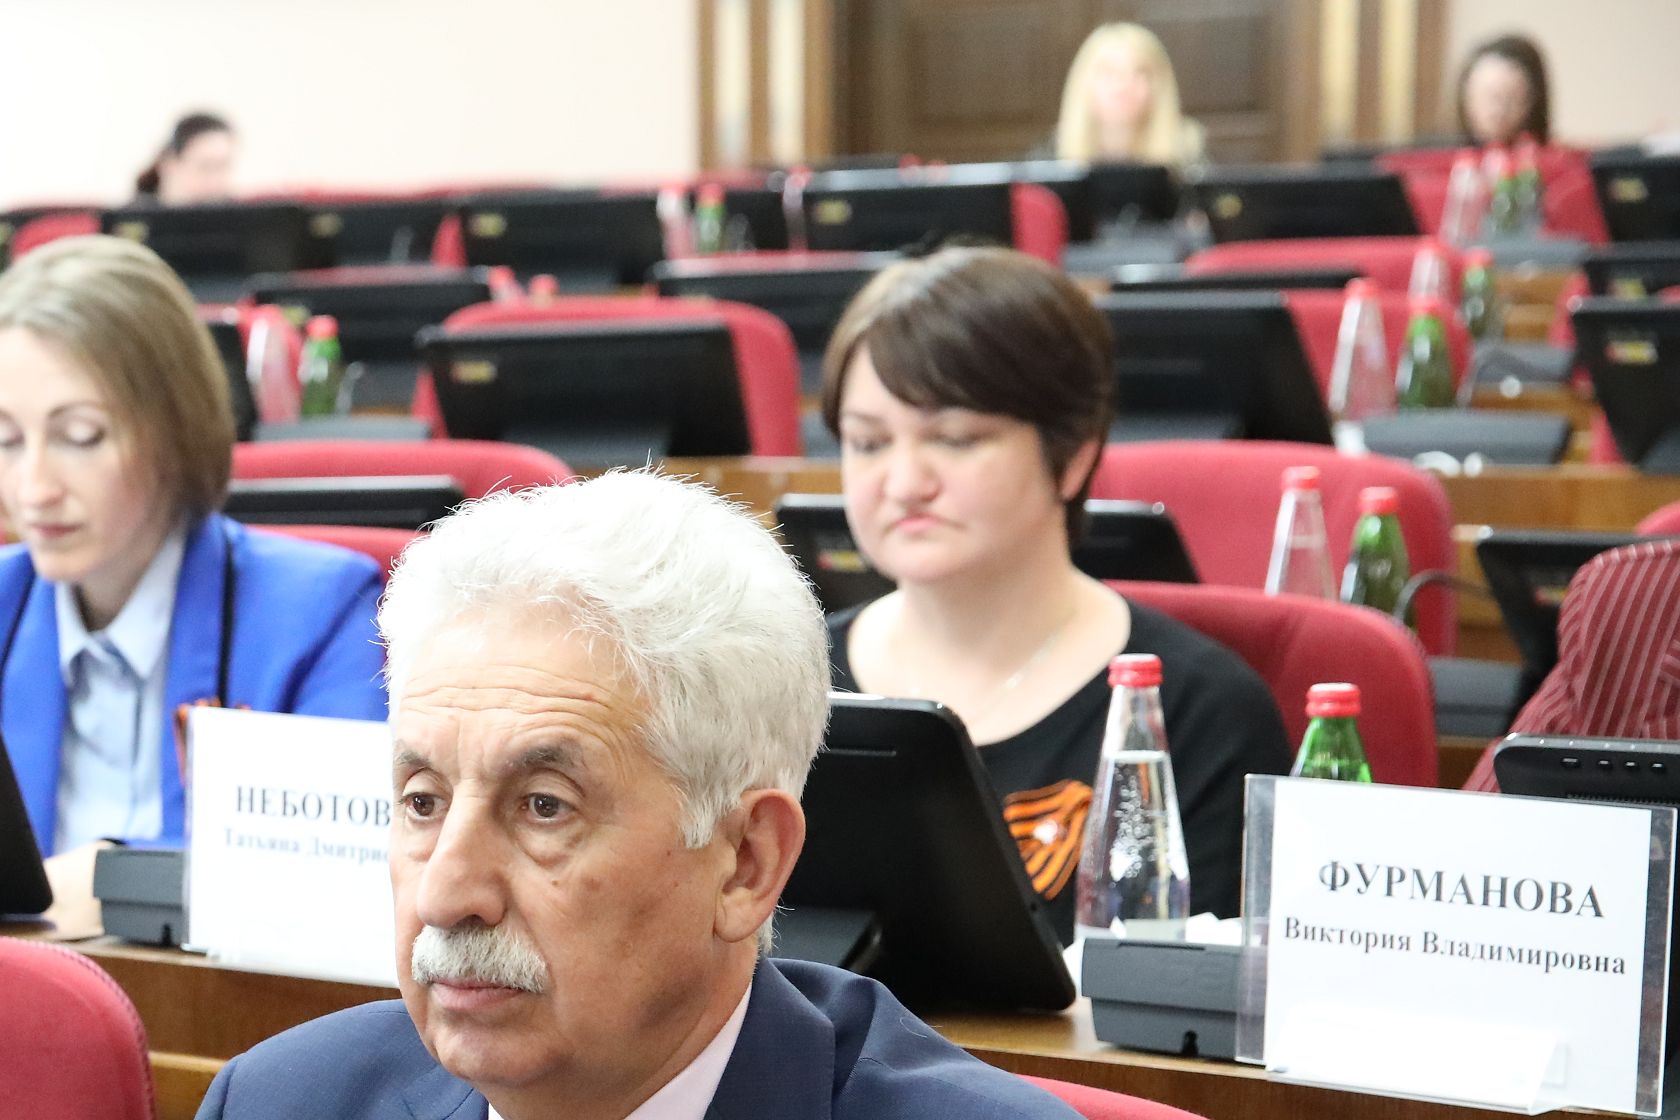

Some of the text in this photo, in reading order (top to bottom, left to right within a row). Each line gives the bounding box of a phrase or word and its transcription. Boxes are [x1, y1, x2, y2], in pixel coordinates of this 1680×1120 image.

[225, 828, 300, 853] Татьяна
[1319, 860, 1604, 918] ФУРМАНОВА
[1284, 916, 1626, 975] Виктория Владимировна
